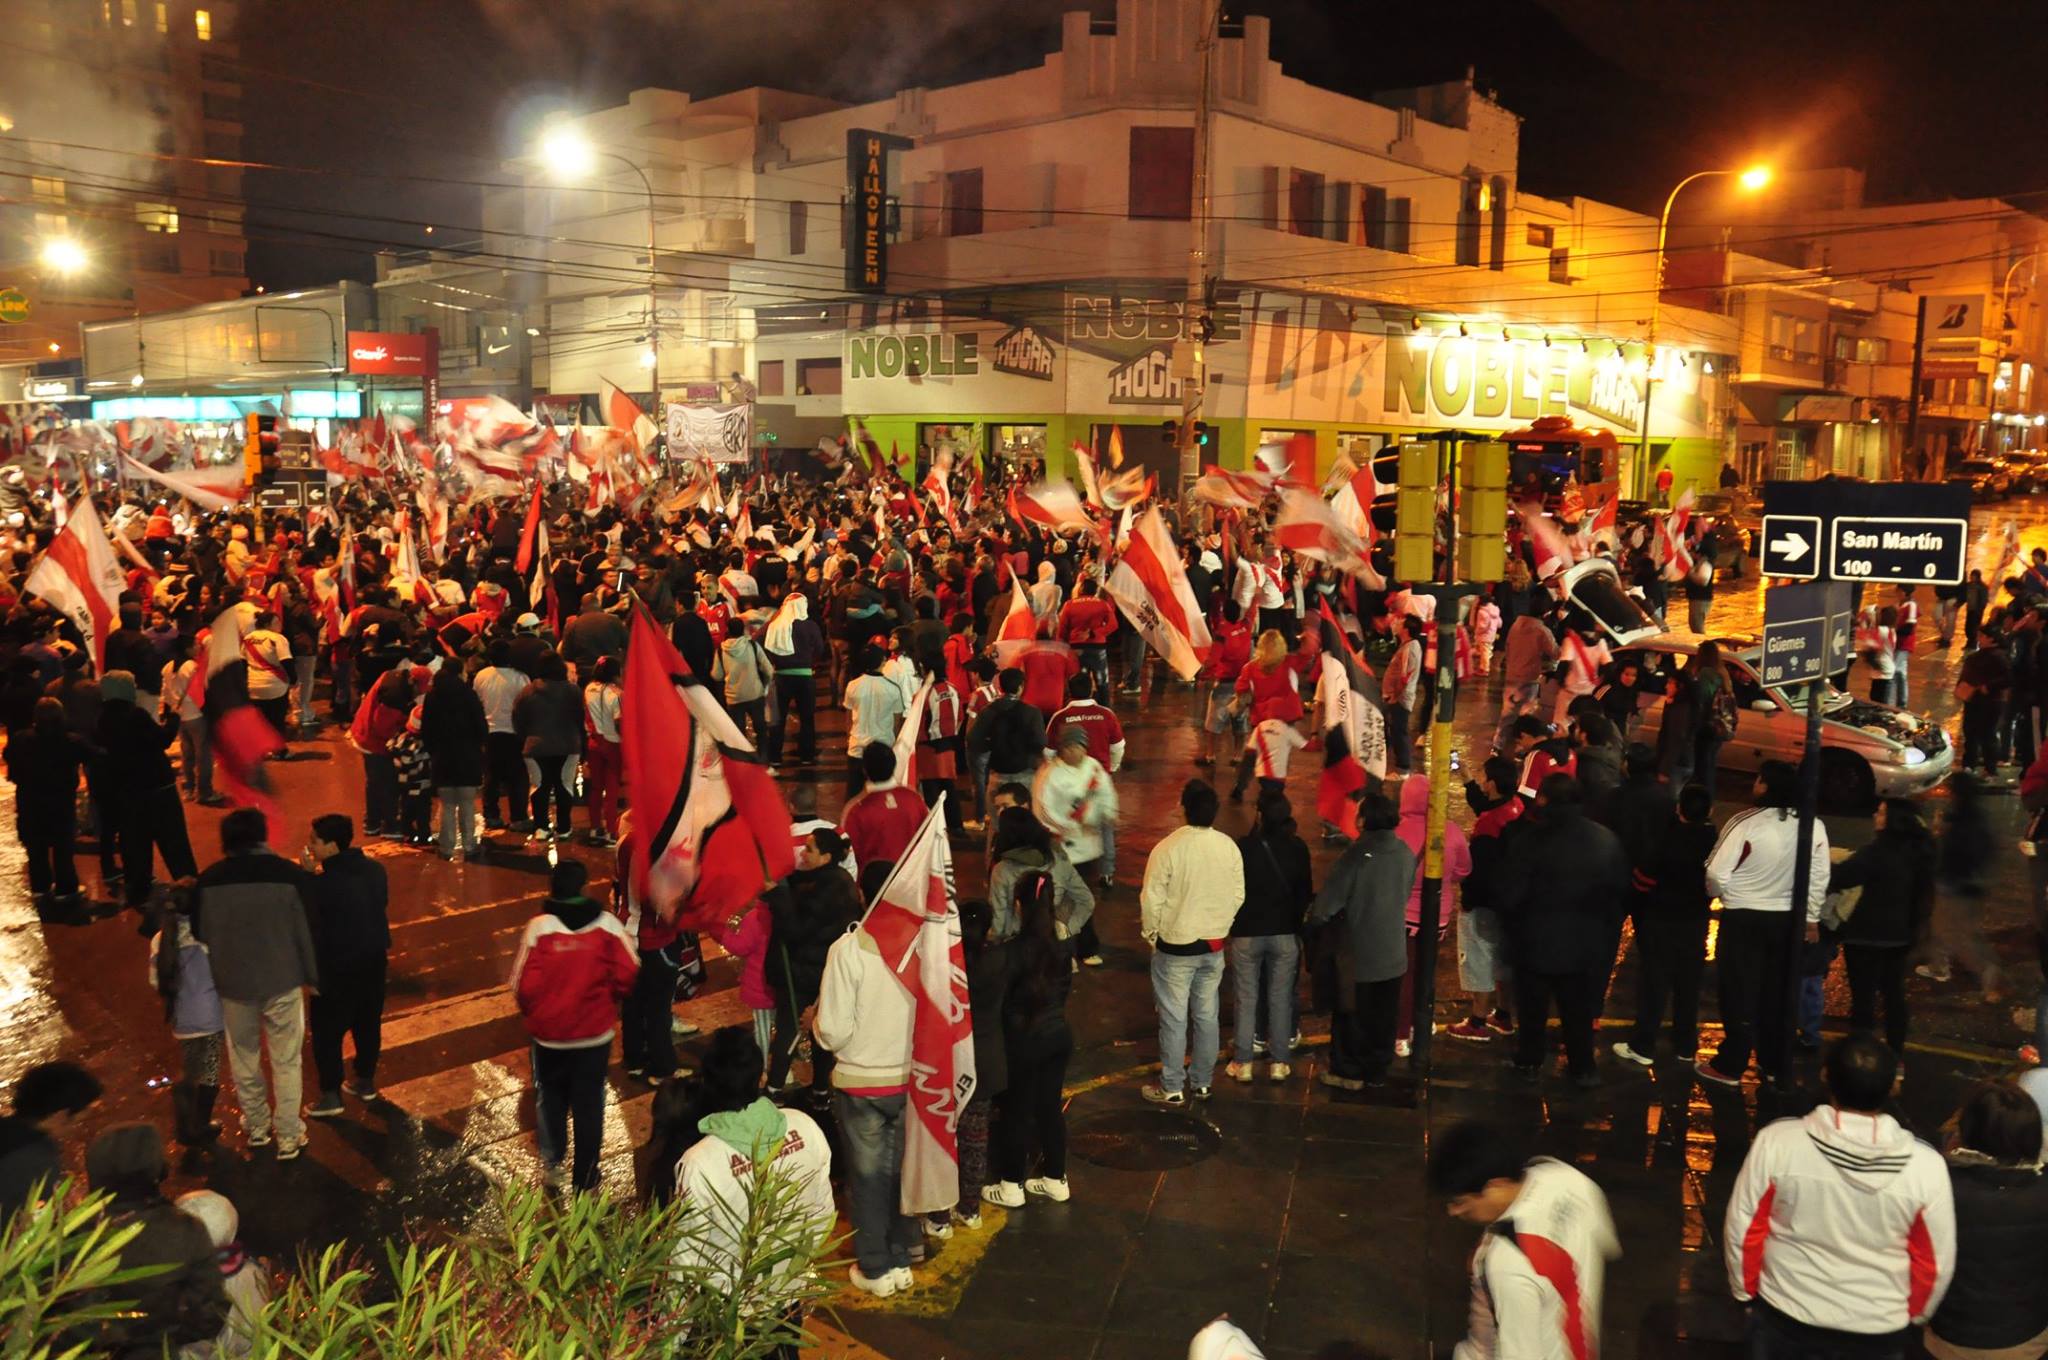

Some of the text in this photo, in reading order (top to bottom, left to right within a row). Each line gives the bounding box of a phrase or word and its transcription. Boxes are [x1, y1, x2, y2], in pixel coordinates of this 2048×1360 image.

[864, 138, 881, 284] HALLOWEEN
[1072, 297, 1243, 343] NOBE
[850, 327, 1052, 378] NOBLE HOGAR
[1115, 350, 1183, 399] HOGA
[1383, 322, 1569, 419] NOBLE
[1842, 531, 1943, 551] San Martín
[1842, 560, 1872, 575] 100
[1923, 563, 1936, 578] 0
[1767, 636, 1806, 653] Güemes
